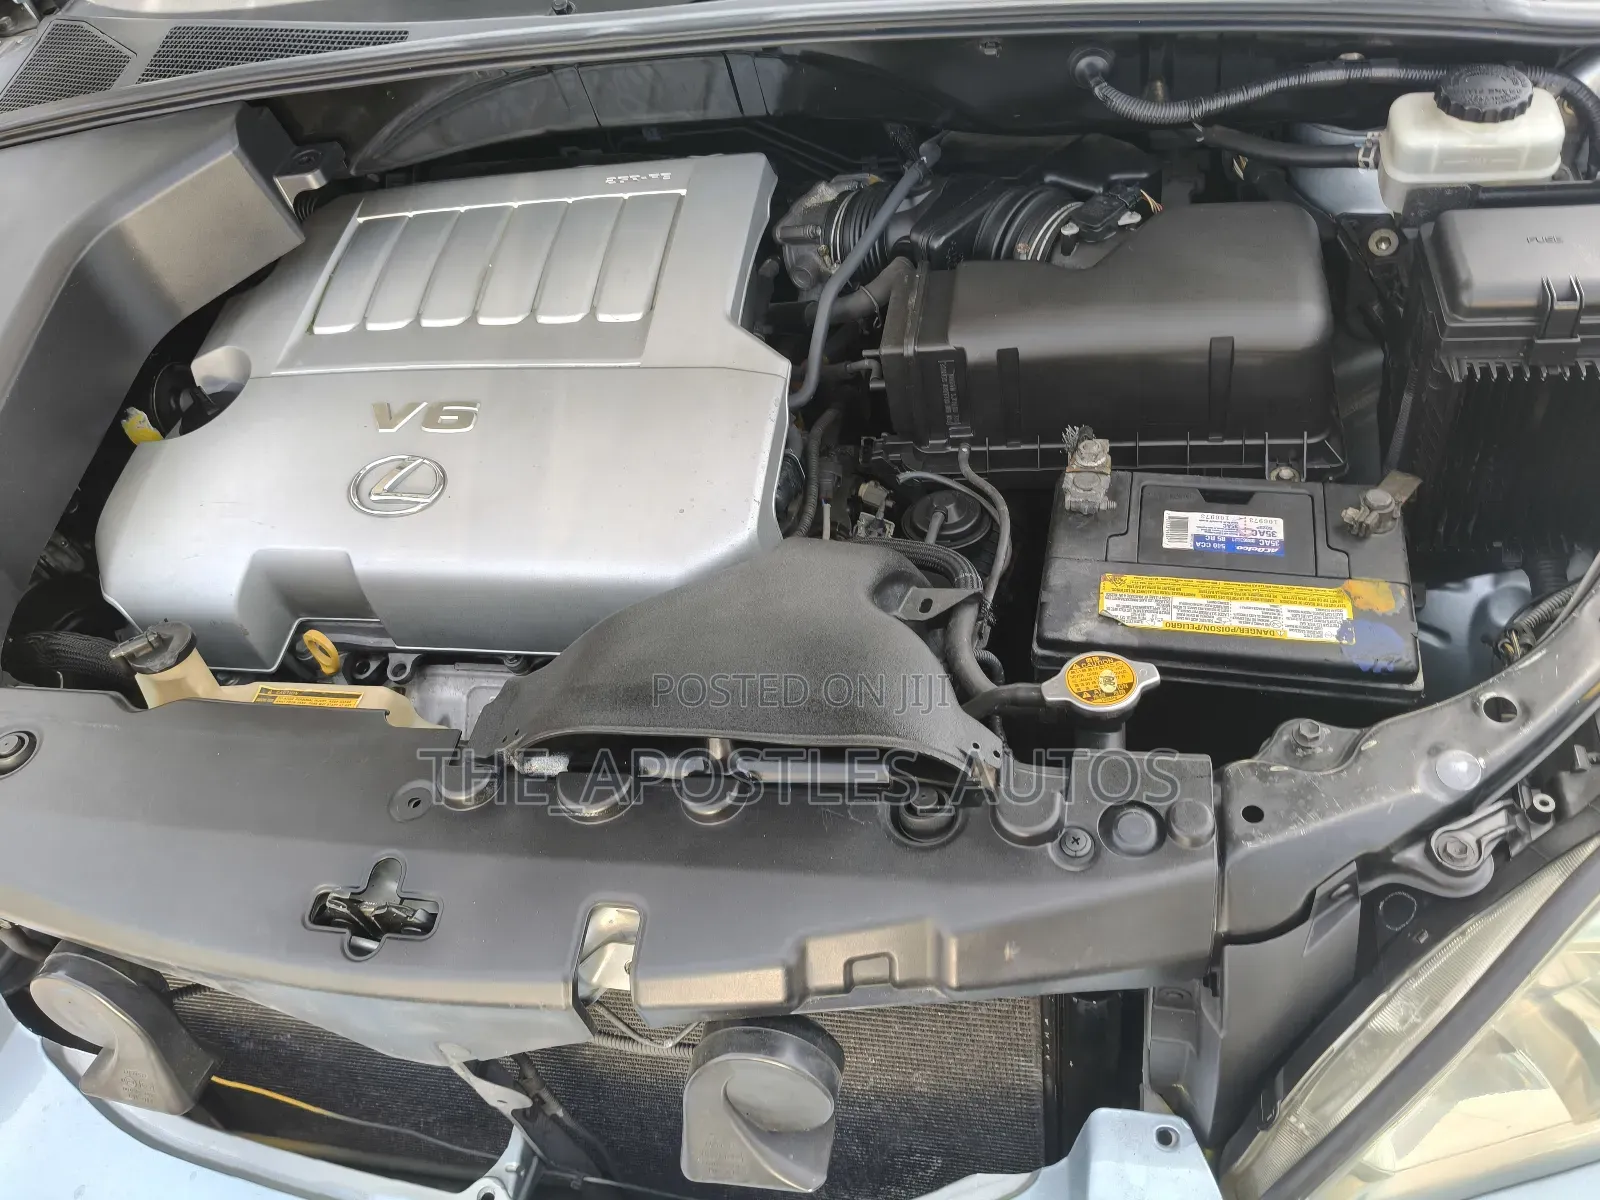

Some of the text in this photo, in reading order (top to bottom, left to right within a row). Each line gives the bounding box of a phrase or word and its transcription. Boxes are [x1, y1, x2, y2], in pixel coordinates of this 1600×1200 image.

[372, 400, 481, 433] V6
[1251, 529, 1278, 538] 35AC
[1259, 539, 1280, 547] 35AC
[1236, 545, 1279, 553] ACDelco
[1165, 621, 1275, 637] DANGER/POISON/PELIGRO
